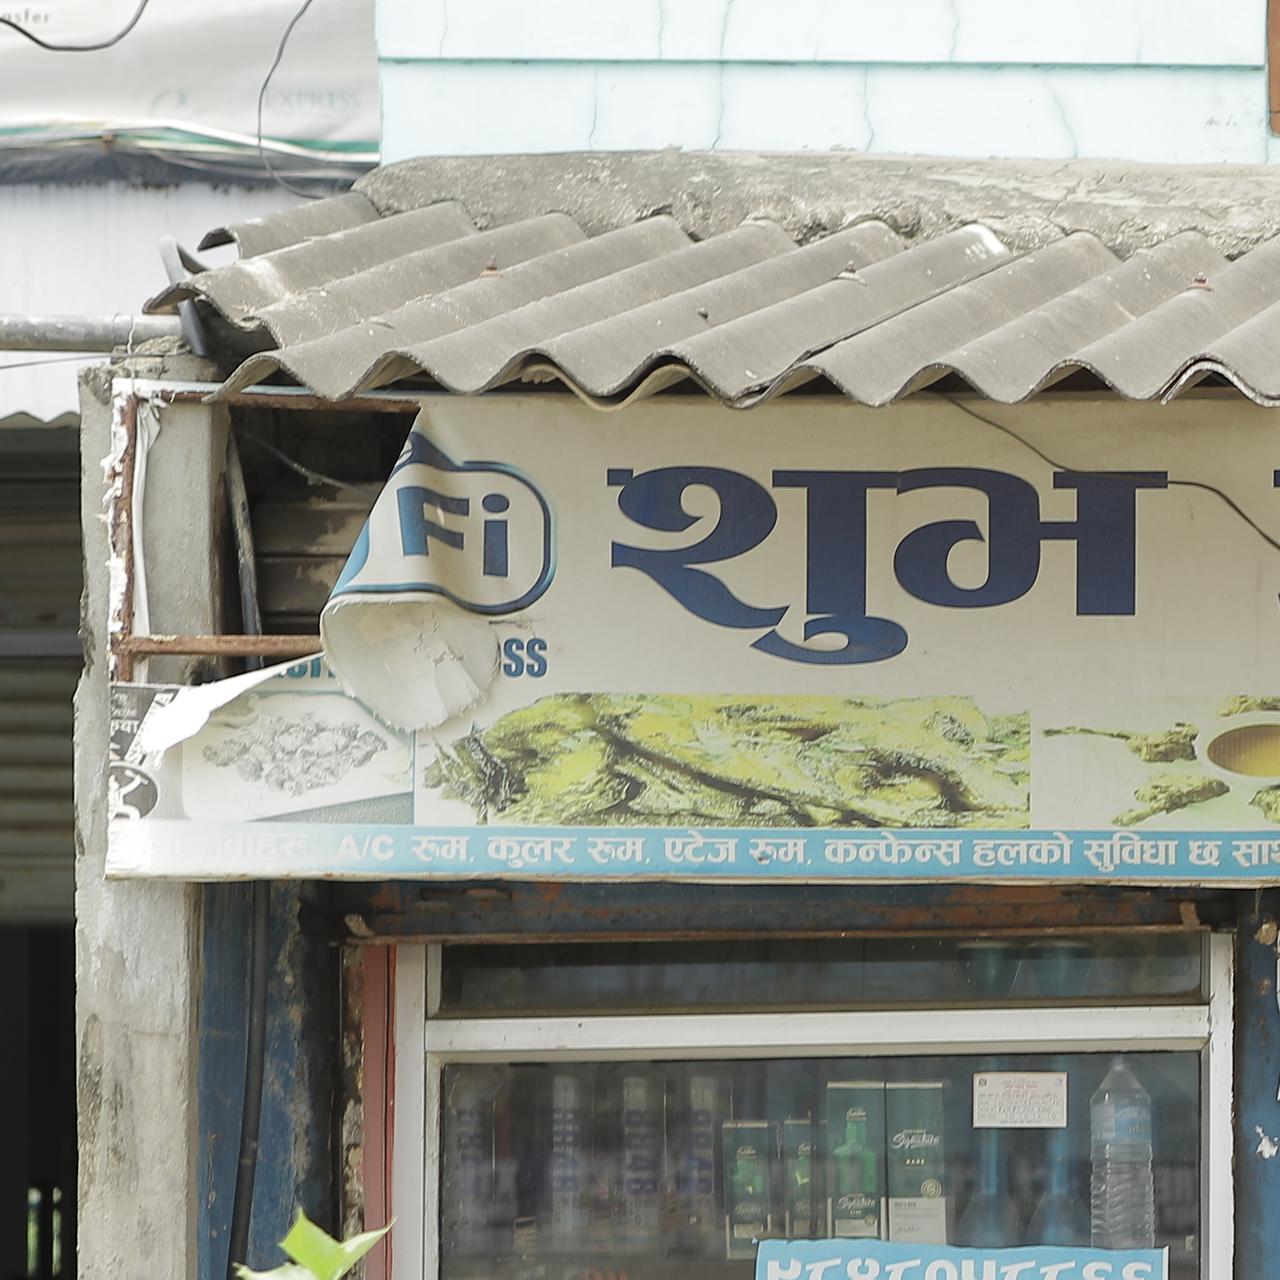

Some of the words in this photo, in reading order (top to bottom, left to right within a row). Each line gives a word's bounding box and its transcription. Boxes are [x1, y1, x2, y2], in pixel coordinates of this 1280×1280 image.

[606, 465, 1169, 665] शुभ
[336, 834, 394, 861] A/C
[487, 837, 577, 868] कुलर
[664, 830, 738, 863] एटेज
[972, 833, 1073, 867] हलको
[1083, 832, 1178, 873] सुविधा
[1189, 840, 1223, 867] छ
